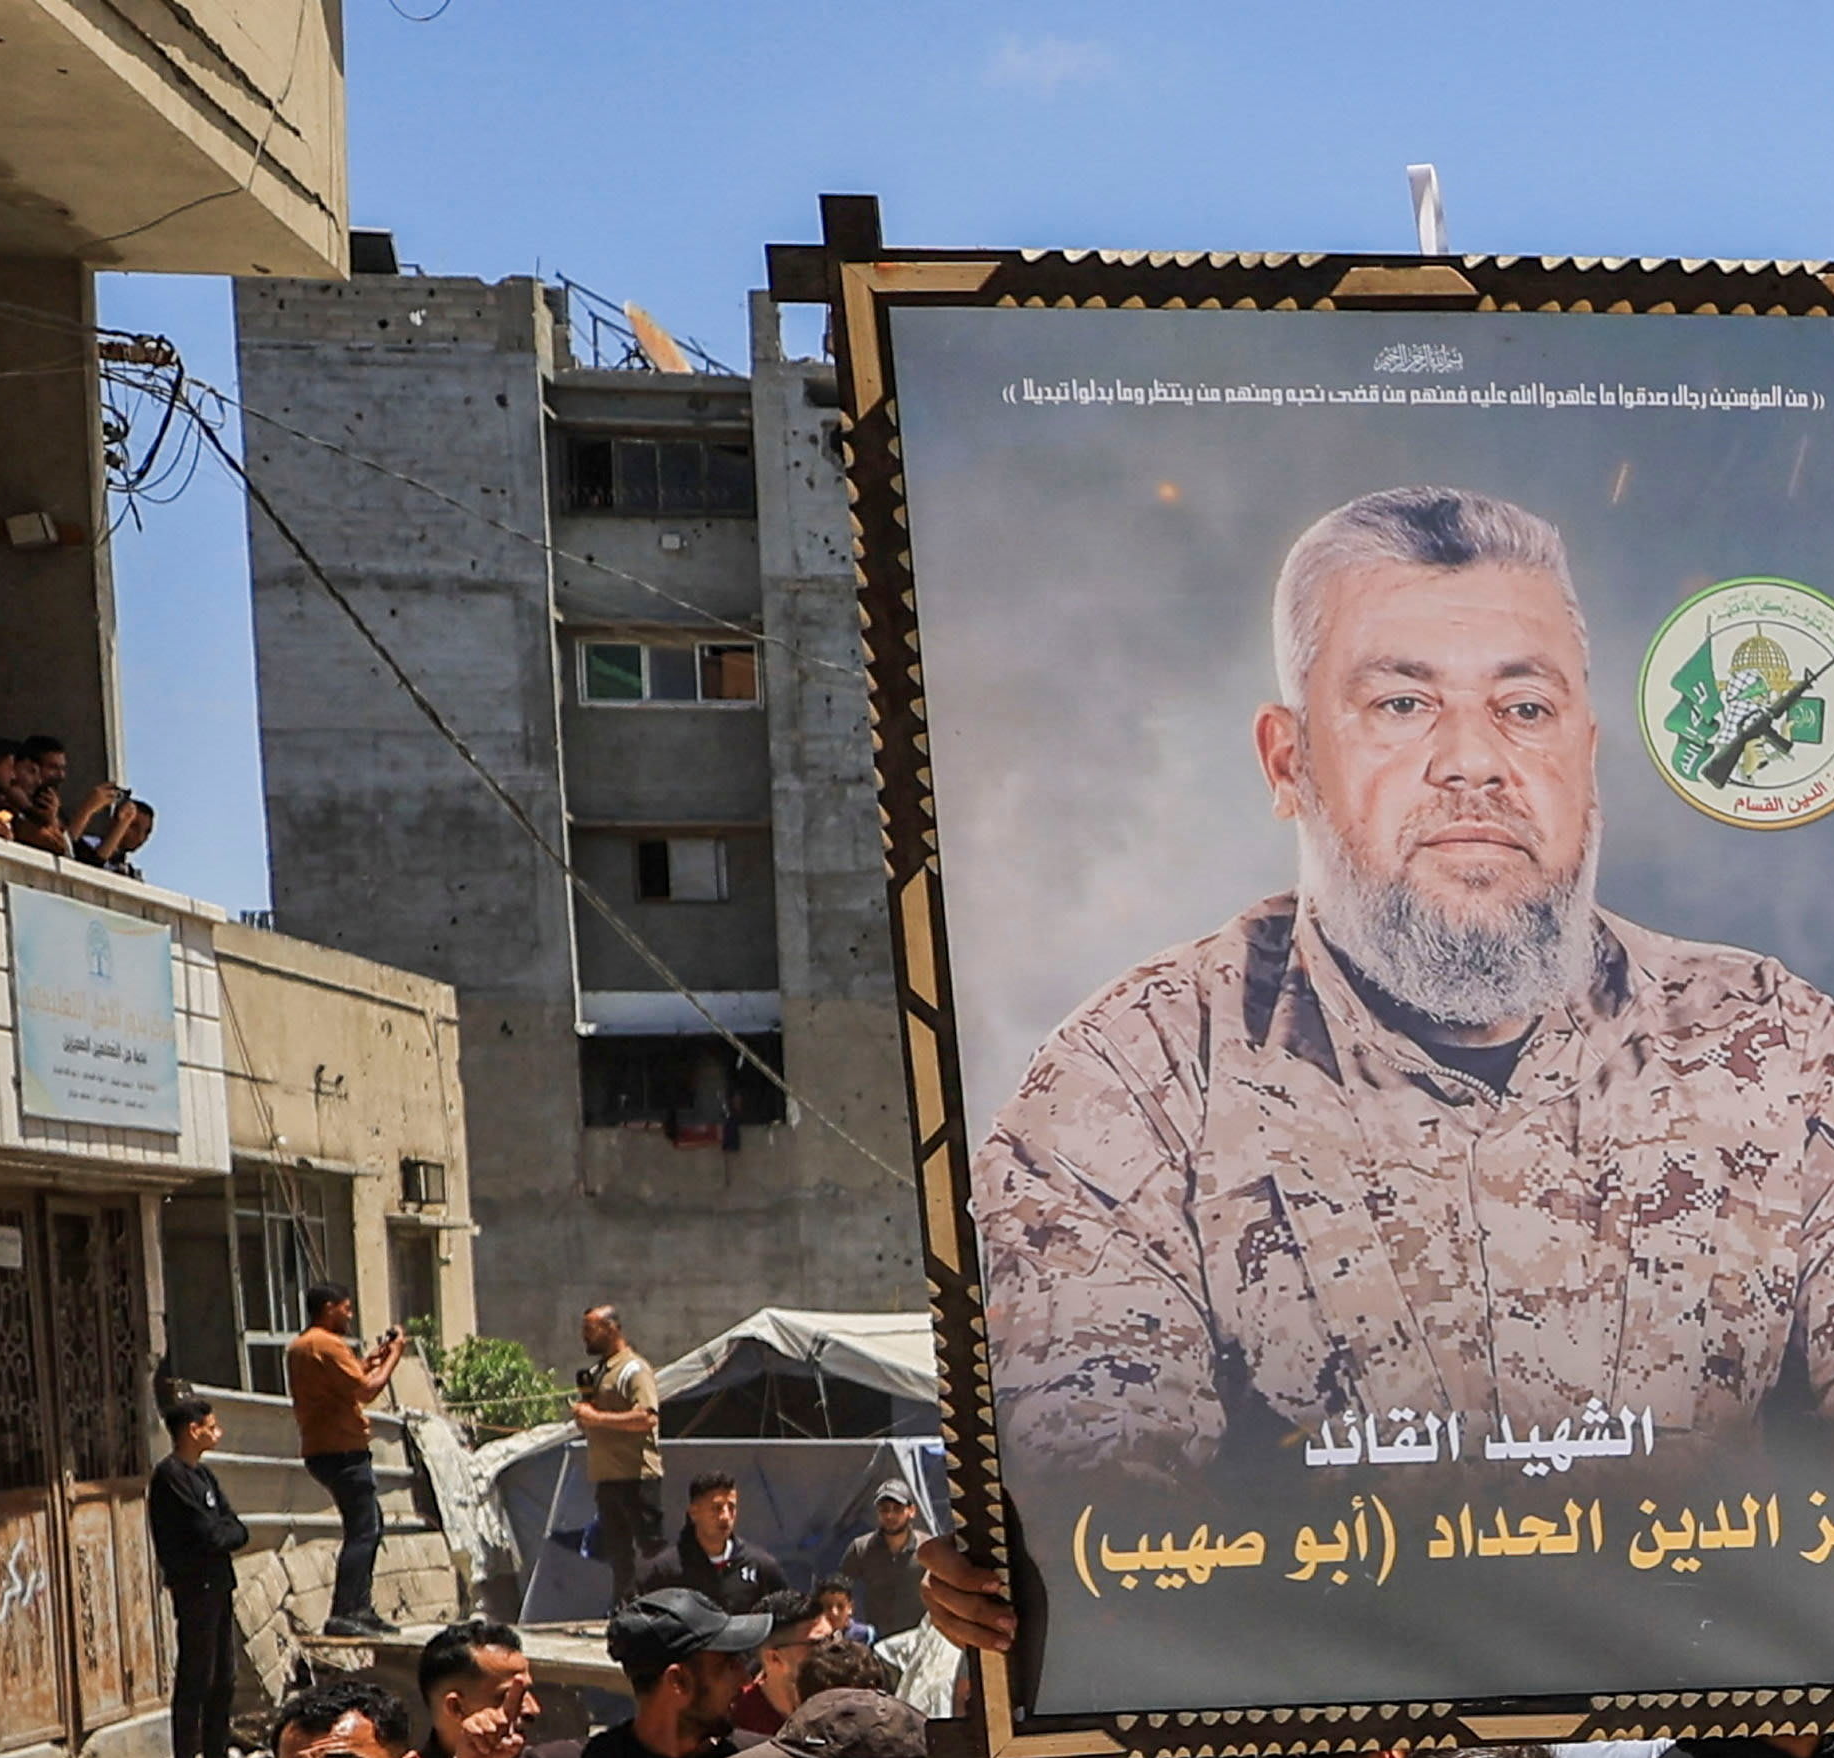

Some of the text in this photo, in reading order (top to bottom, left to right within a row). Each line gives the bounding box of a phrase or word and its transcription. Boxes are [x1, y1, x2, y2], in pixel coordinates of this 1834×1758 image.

[1022, 377, 1071, 406] تبديلا
[1072, 378, 1115, 406] بدلوا
[1116, 378, 1146, 405] وما
[1147, 379, 1194, 405] ينتظر
[1196, 383, 1221, 402] من
[1224, 383, 1284, 406] ومنهم
[1285, 384, 1322, 407] نحبه
[1328, 384, 1379, 404] قضى
[1382, 384, 1406, 404] من
[1410, 385, 1468, 406] فمنهم
[1470, 382, 1508, 409] عليه
[1510, 382, 1537, 406] الله
[1539, 383, 1597, 409] عاهدوا
[1599, 383, 1617, 406] ما
[1618, 383, 1669, 410] صدقوا
[1672, 384, 1708, 410] رجال
[1710, 384, 1783, 411] المؤمنين
[1785, 388, 1809, 408] من
[1733, 796, 1785, 814] القسام
[1304, 1402, 1656, 1478] الشهيد القائد
[1426, 1498, 1603, 1560] الحداد
[1627, 1492, 1781, 1574] الدين
